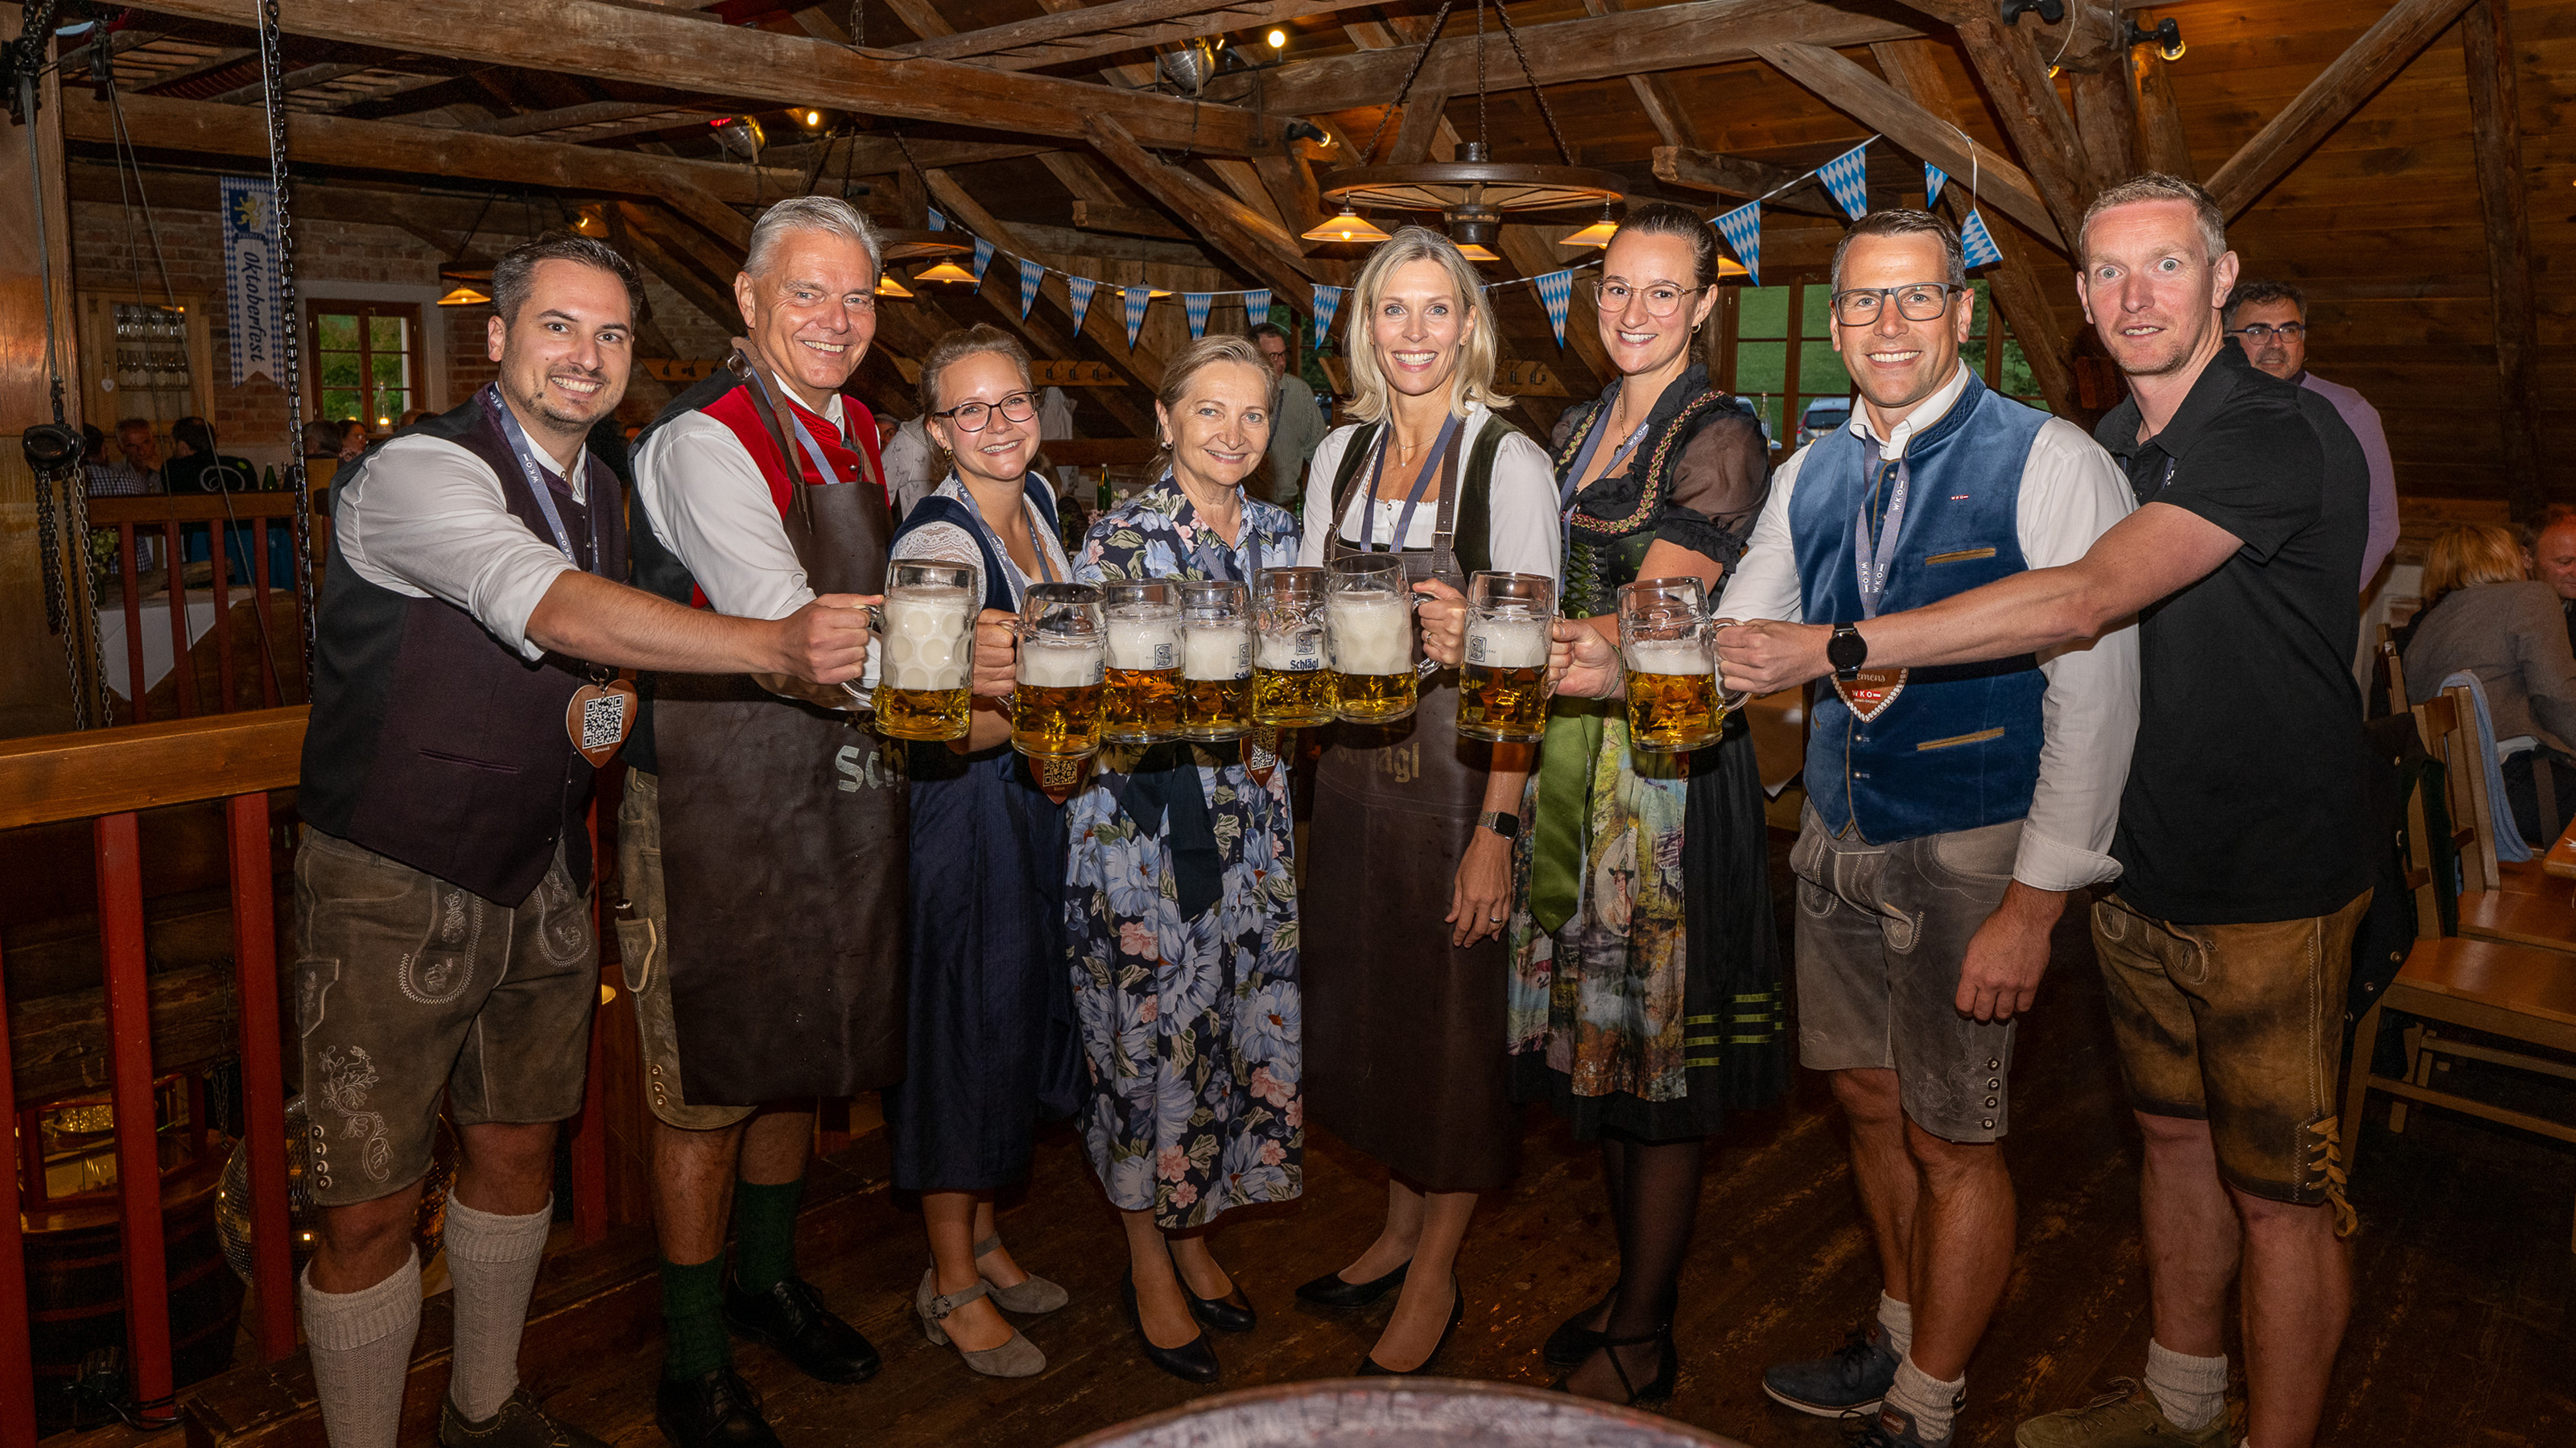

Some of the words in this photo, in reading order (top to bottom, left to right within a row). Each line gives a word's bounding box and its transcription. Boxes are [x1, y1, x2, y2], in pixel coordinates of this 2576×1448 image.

[242, 251, 267, 362] Oktoberfest
[1628, 429, 1644, 446] WKO
[525, 460, 540, 484] WKO
[956, 482, 969, 499] WKO
[1893, 488, 1905, 511] WKO
[561, 539, 573, 562] WKO
[995, 542, 1008, 562] WKO
[1861, 562, 1870, 584] WKO
[1872, 571, 1884, 593] WKO
[1290, 658, 1319, 670] Schlägl
[1856, 673, 1886, 683] emens
[1852, 689, 1873, 698] WKO
